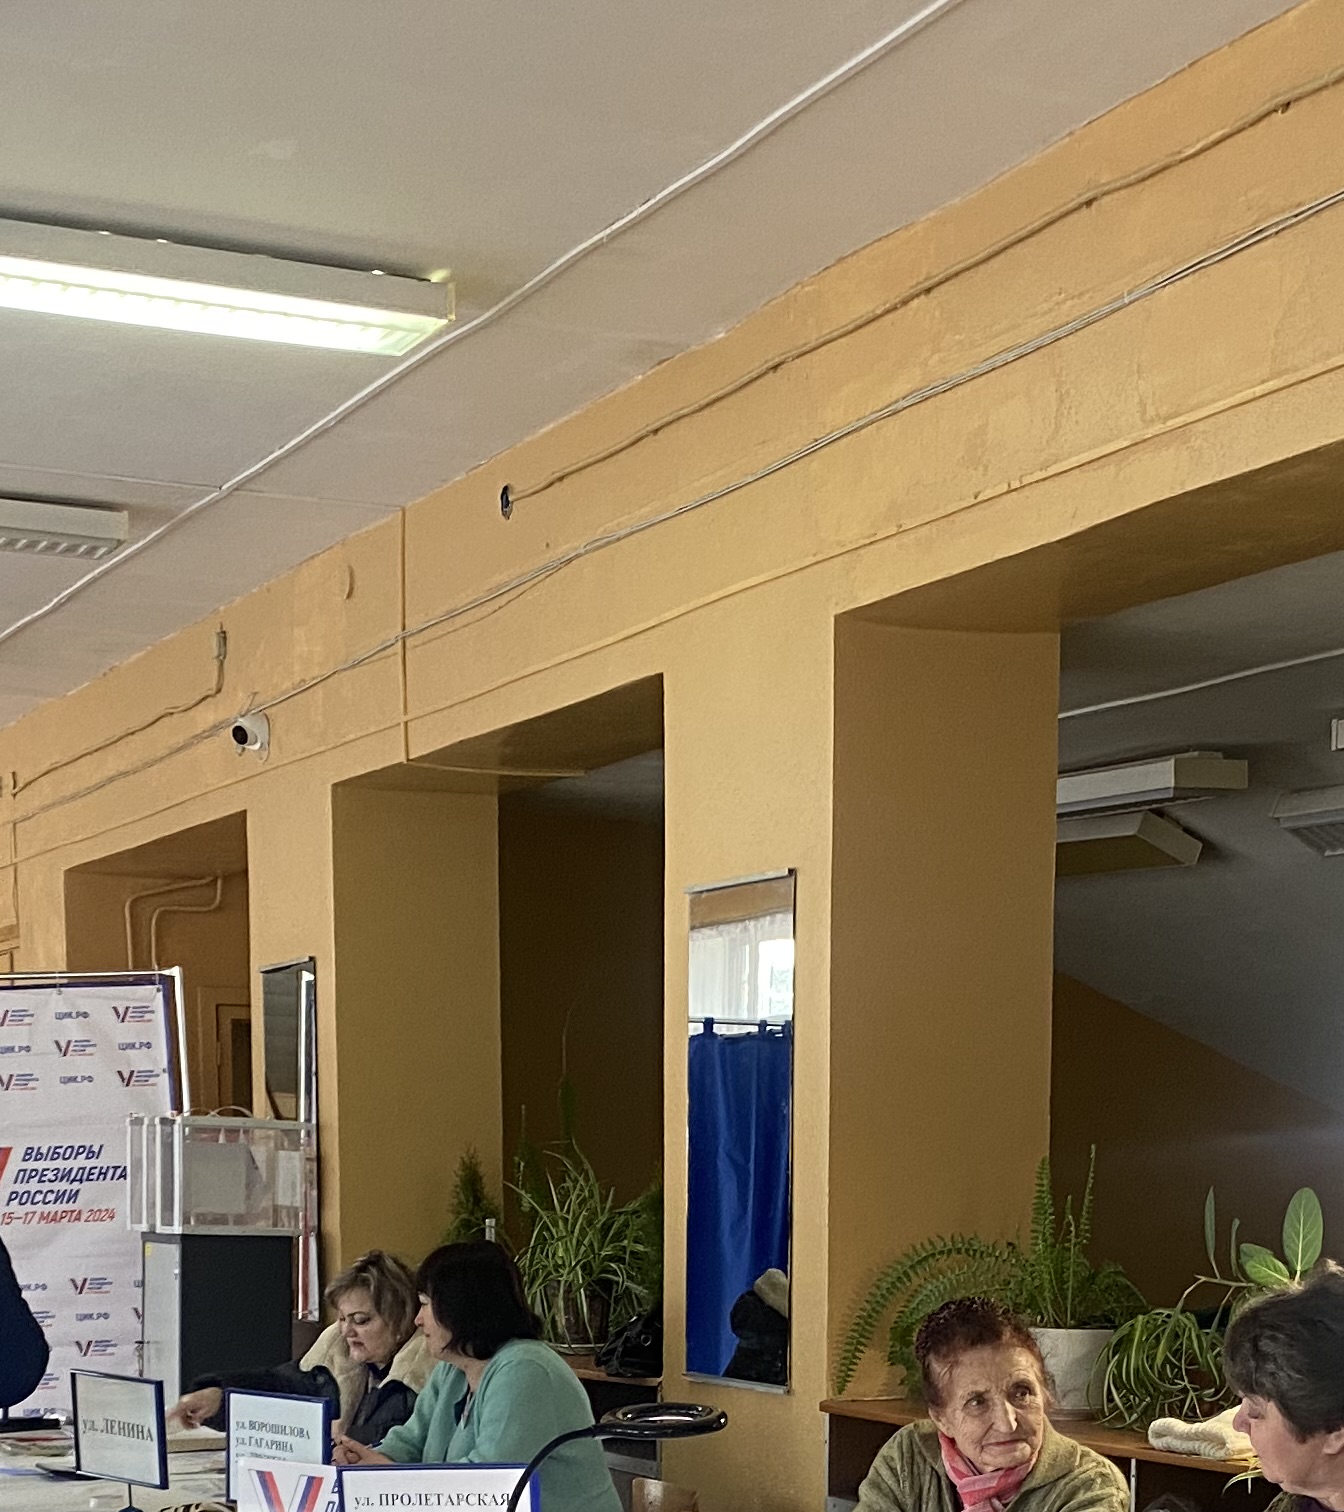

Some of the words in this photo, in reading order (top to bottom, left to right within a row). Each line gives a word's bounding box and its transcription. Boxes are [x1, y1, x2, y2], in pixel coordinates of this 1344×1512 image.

[21, 1144, 104, 1162] ВЫБОРЫ
[13, 1165, 127, 1185] ПРЕЗИДЕНТА
[6, 1188, 81, 1206] РОССИИ
[38, 1209, 82, 1225] МАРТА
[84, 1208, 116, 1223] 2024
[82, 1418, 99, 1434] ул.
[100, 1418, 154, 1442] ЛЕНИНА
[248, 1420, 311, 1439] ВОРОШИЛОВА
[248, 1436, 295, 1453] ГАГАРИНА
[355, 1496, 375, 1510] ул.
[379, 1493, 510, 1507] ПРОЛЕТАРСКАЯ
